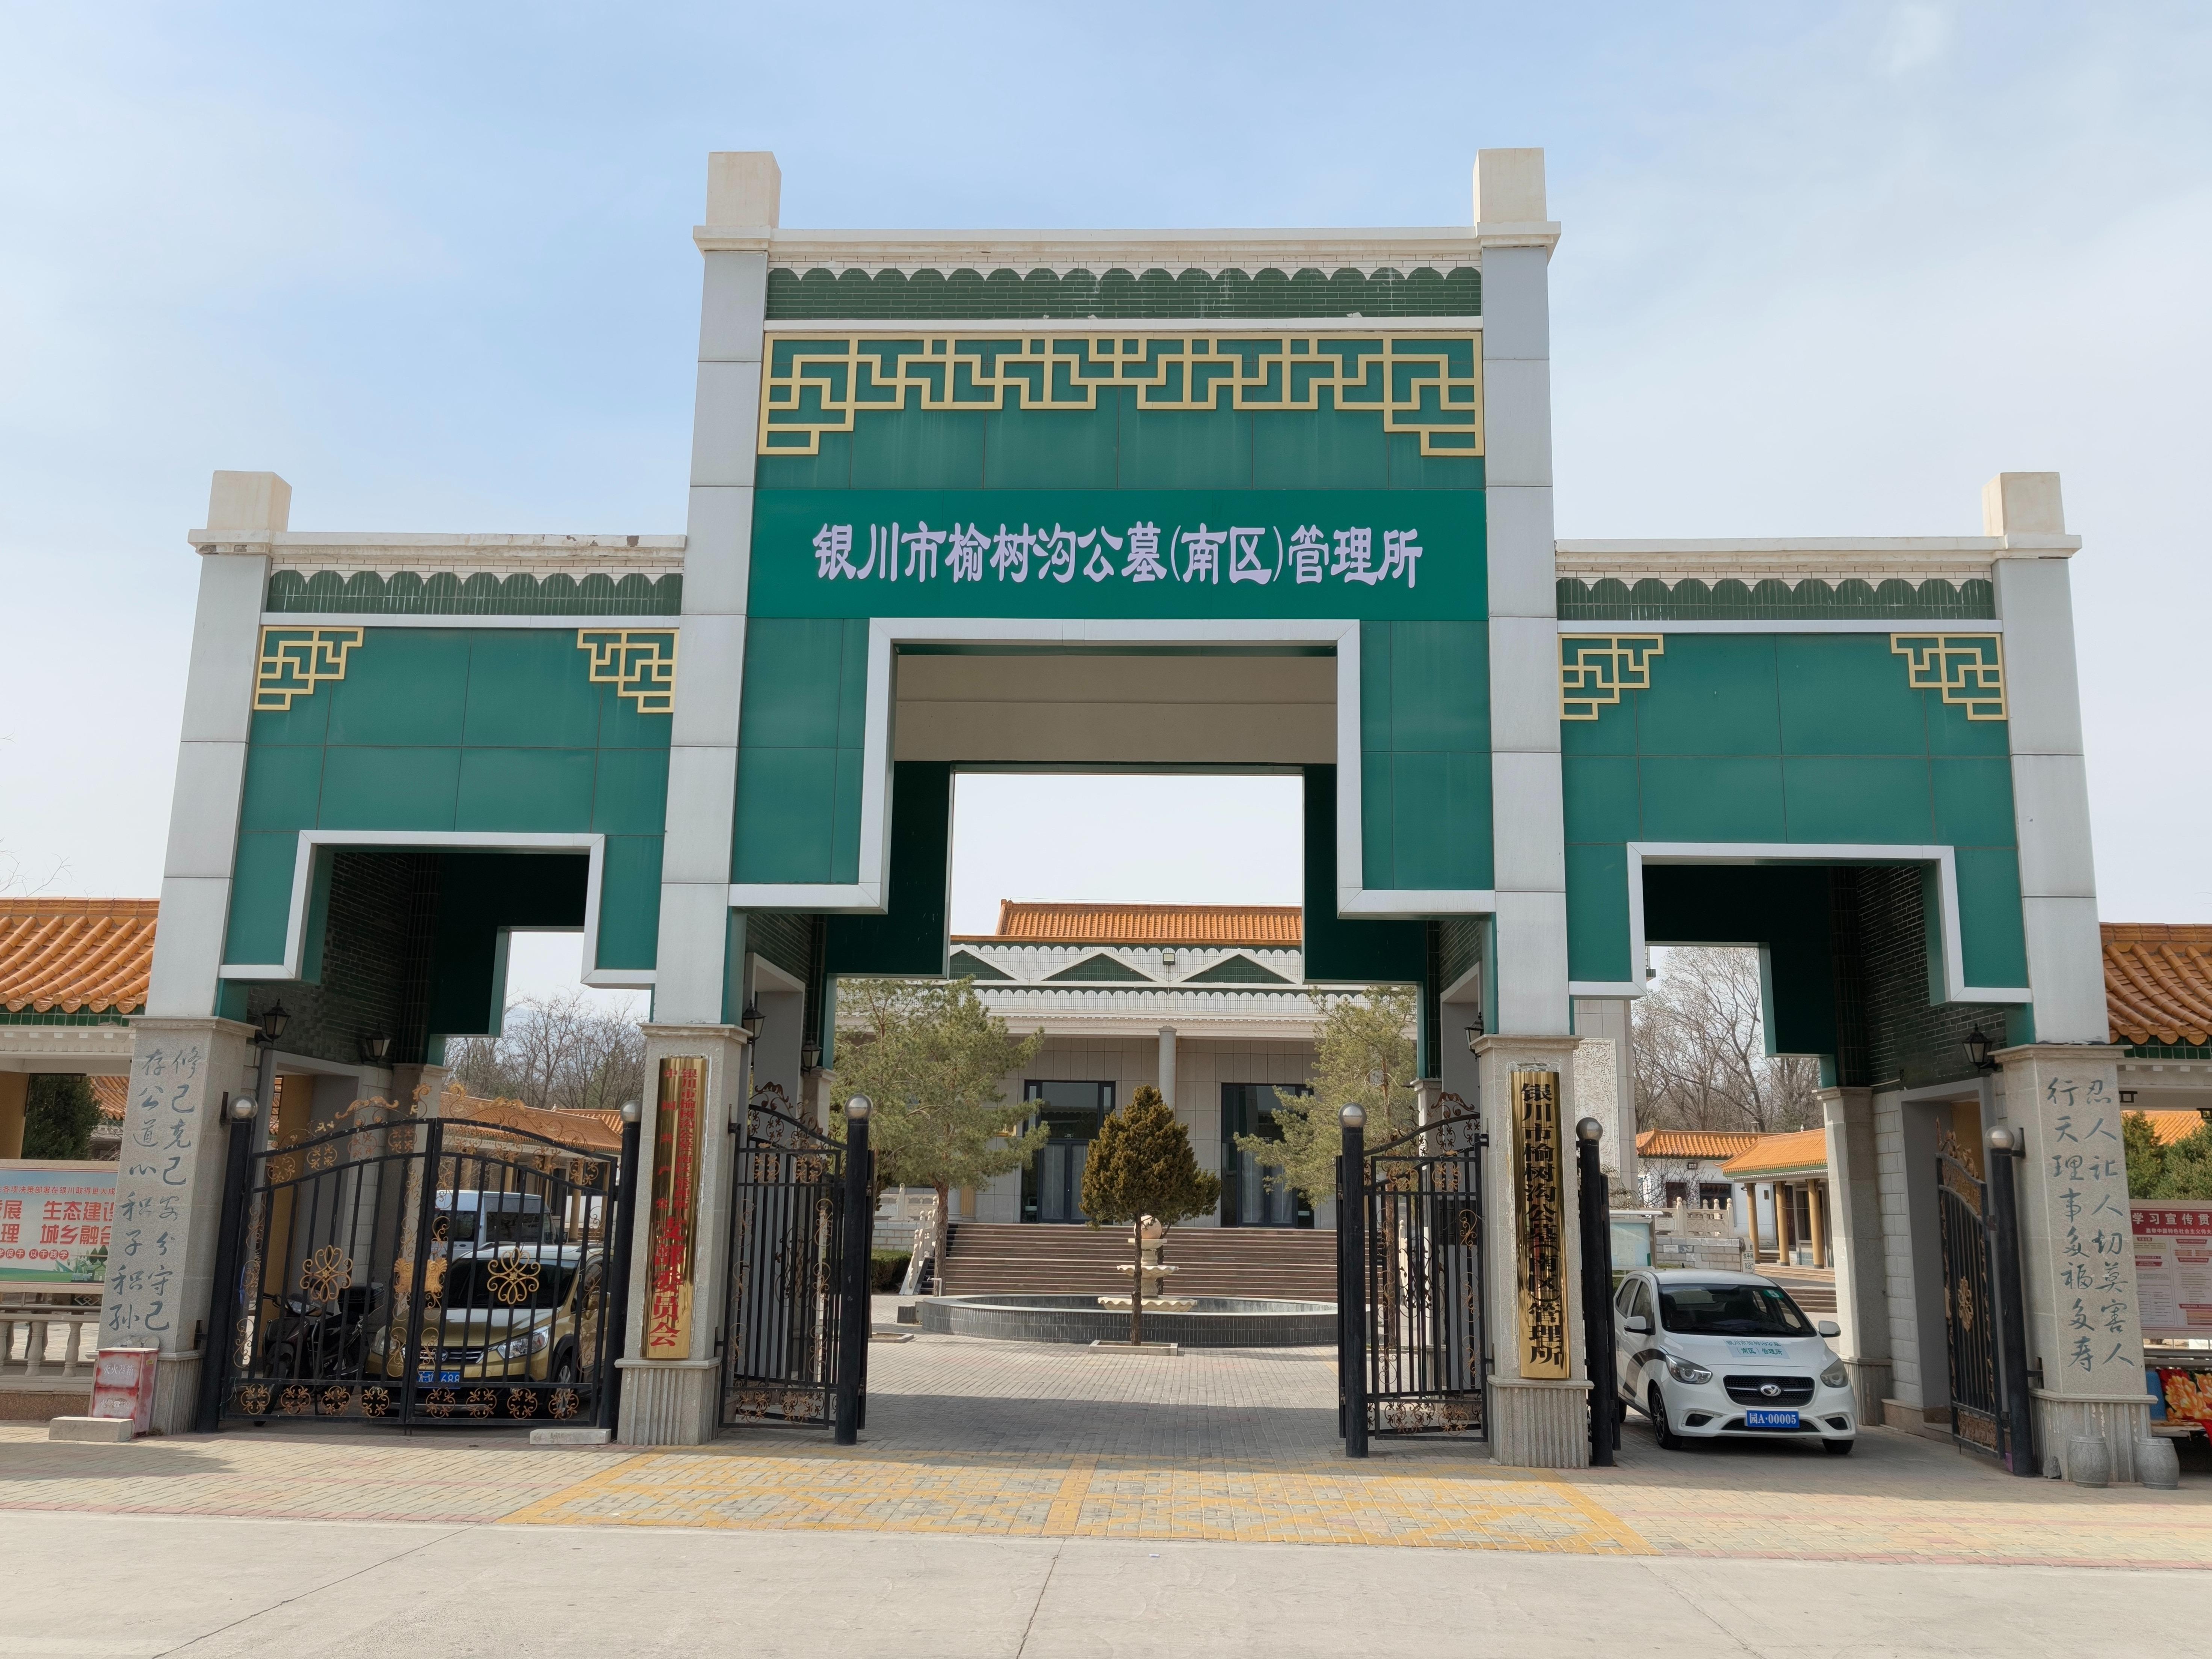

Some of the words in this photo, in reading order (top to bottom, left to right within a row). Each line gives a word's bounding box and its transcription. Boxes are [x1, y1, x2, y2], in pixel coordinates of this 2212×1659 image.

[811, 521, 1423, 588] 银川市榆树沟公墓(南区)管理所
[655, 1068, 677, 1209] 中国共产党
[0, 1185, 115, 1195] 各项决策部署在银川取得更大成
[0, 1200, 22, 1219] 展
[2132, 1213, 2210, 1226] 学习宣传贯
[1, 1224, 20, 1243] 理
[648, 1216, 687, 1347] 支部委员会
[104, 1365, 134, 1375] 灭火器箱
[1750, 1413, 1796, 1424] 园A·00005
